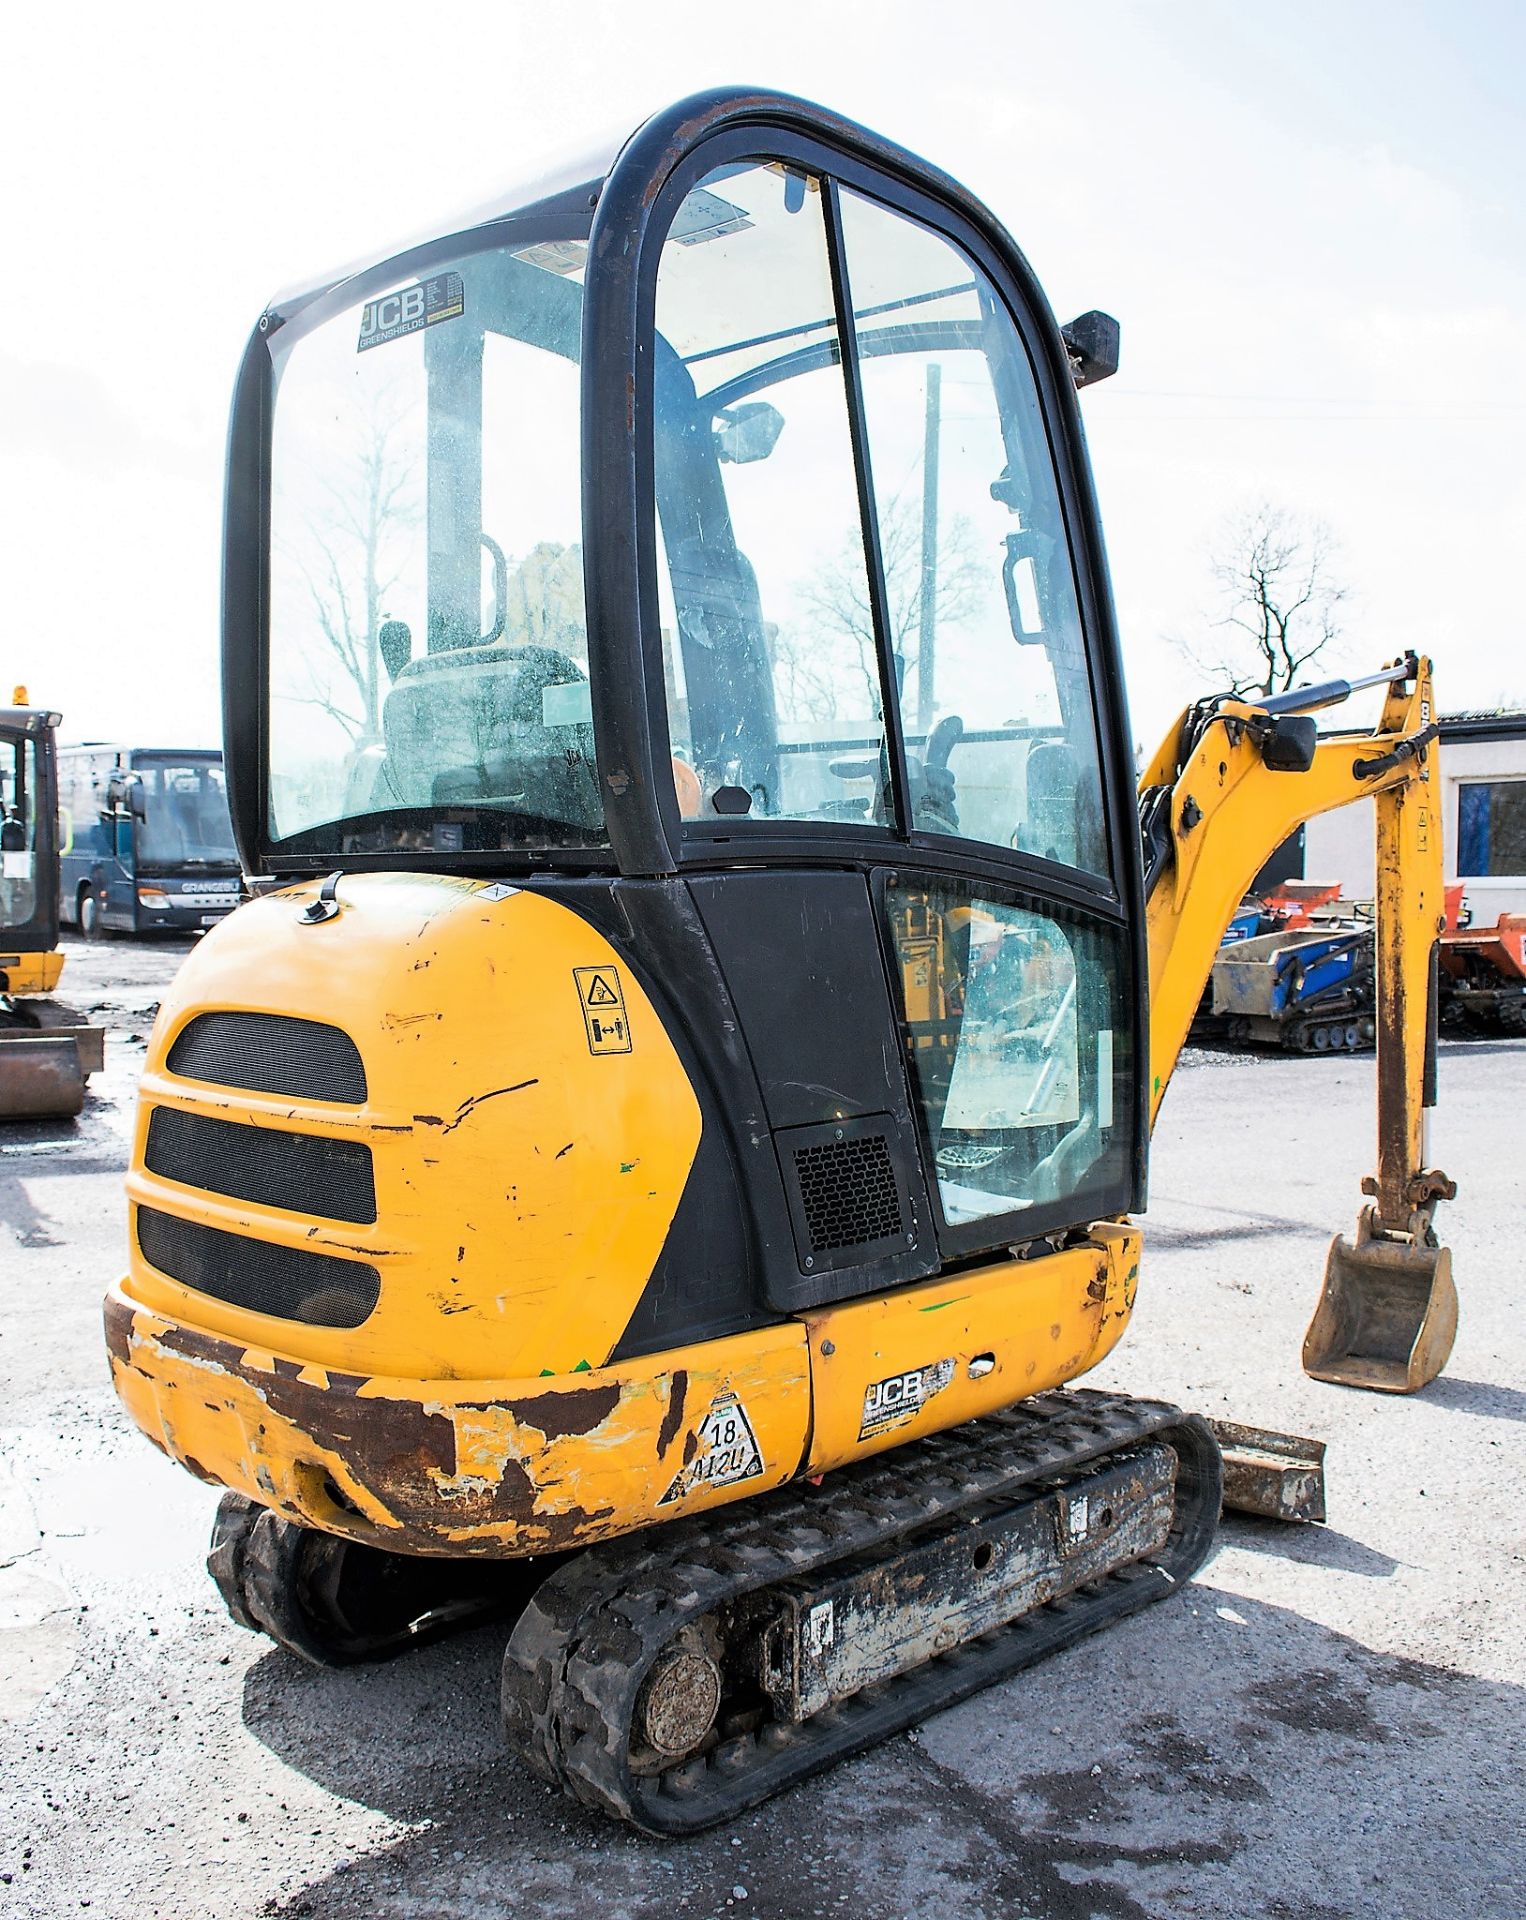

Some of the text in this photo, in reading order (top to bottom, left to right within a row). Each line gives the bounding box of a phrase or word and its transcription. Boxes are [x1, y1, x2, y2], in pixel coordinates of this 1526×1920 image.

[360, 287, 425, 338] JCB
[360, 318, 425, 348] GREENSHIELDS
[866, 1371, 923, 1411] JCB
[710, 1419, 736, 1450] 18
